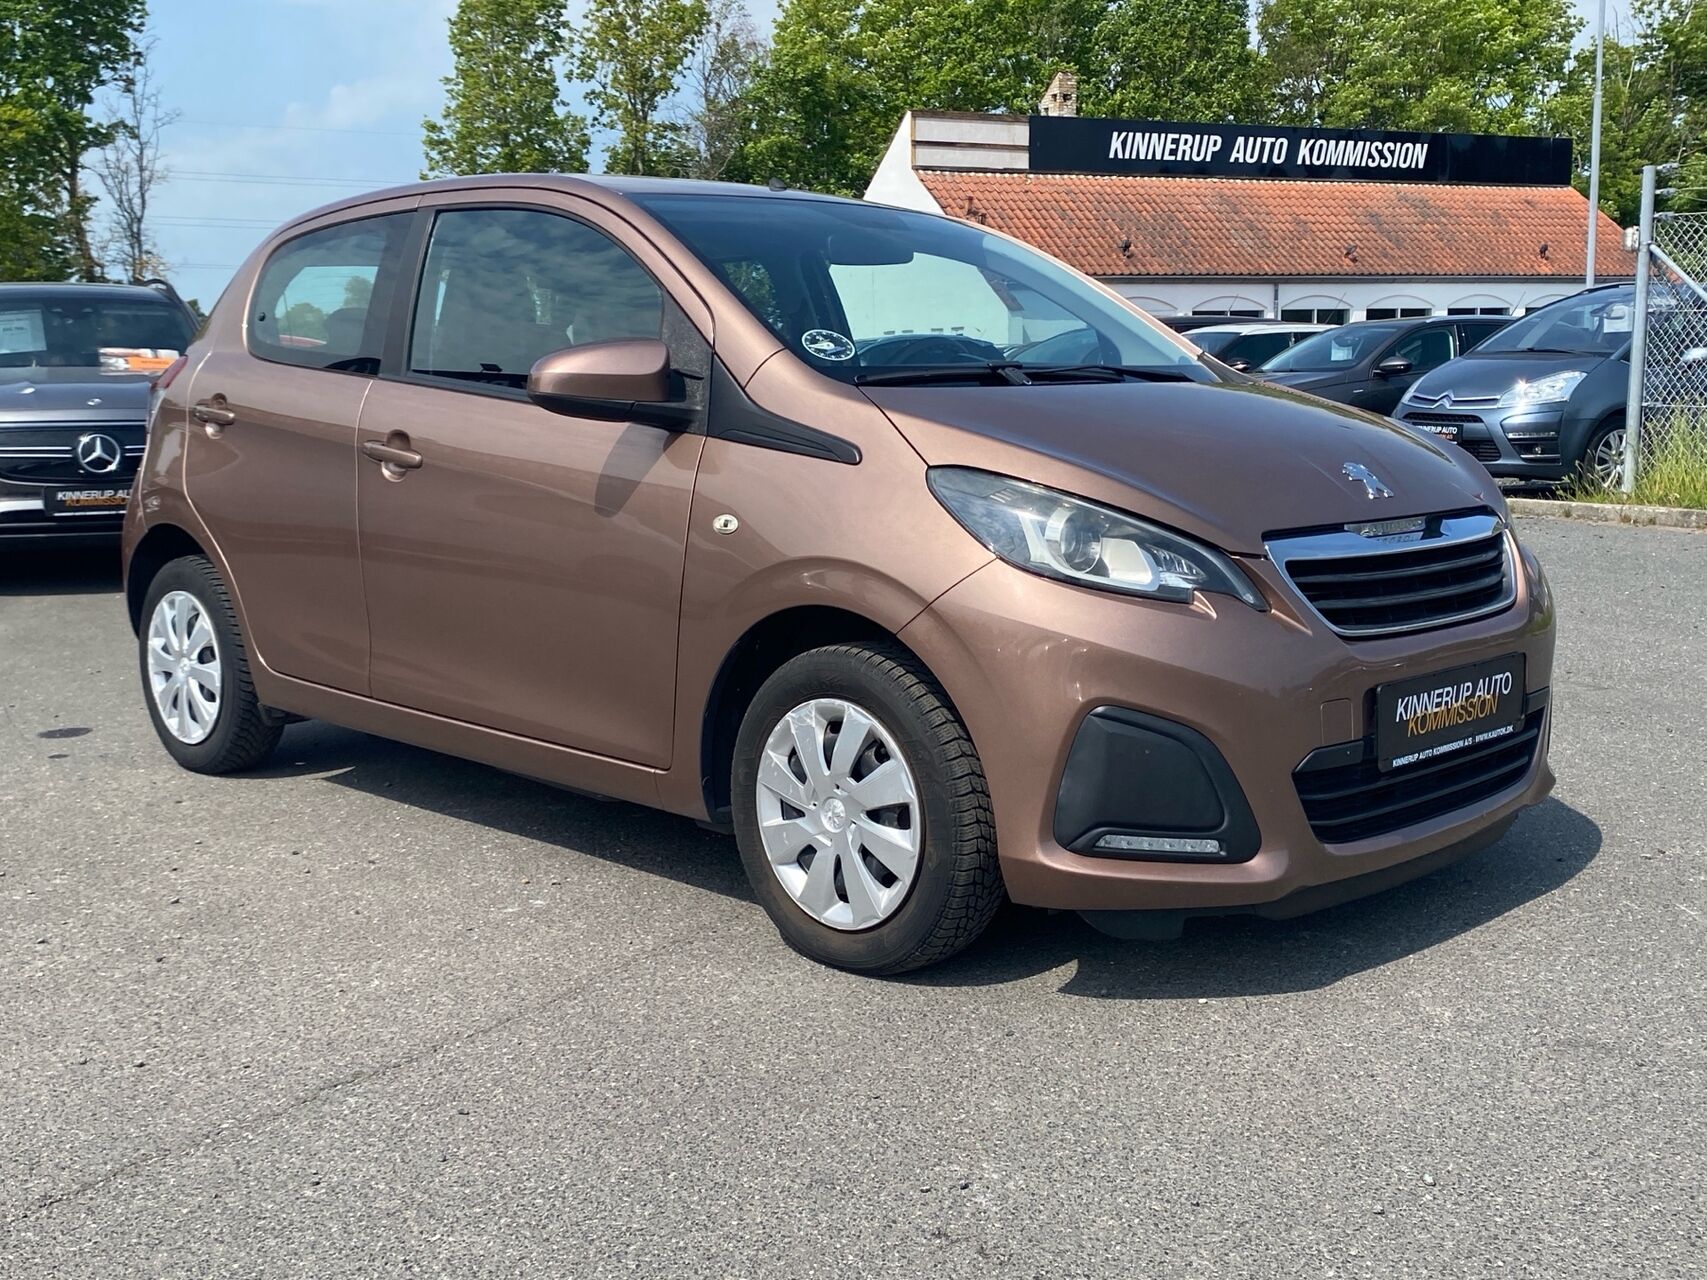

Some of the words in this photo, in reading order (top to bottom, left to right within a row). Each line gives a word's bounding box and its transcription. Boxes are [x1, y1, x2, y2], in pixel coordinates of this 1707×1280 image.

[1109, 131, 1222, 162] KINNERUP
[1229, 136, 1288, 165] AUTO
[1297, 138, 1428, 169] KOMMISSION
[1442, 426, 1457, 434] AUTO
[57, 490, 115, 501] KINNERUP
[1395, 681, 1473, 722] KINNERUP
[1473, 672, 1512, 704] AUTO
[1407, 694, 1499, 737] KOMMISSION
[1392, 753, 1419, 767] KINNERUP
[1419, 749, 1433, 760] AUTO
[1432, 740, 1464, 756] KOMMISSION
